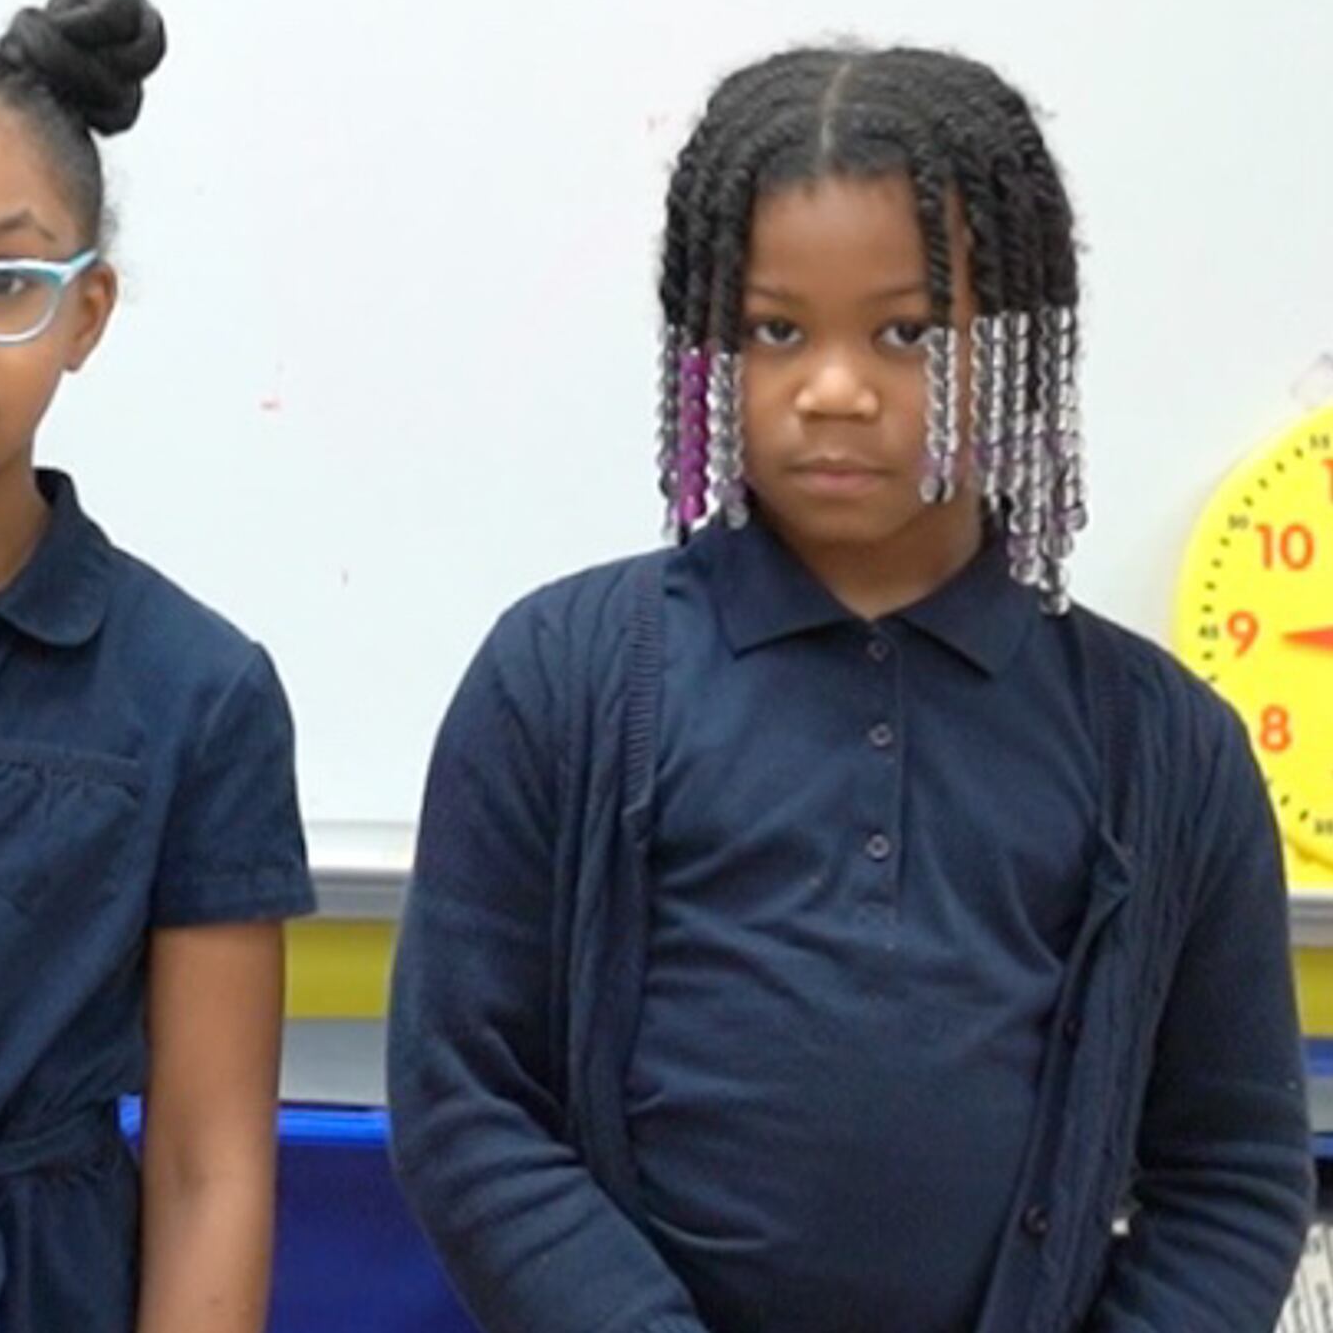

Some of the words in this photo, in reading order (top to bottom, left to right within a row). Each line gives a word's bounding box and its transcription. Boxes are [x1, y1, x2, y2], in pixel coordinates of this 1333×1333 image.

[1254, 522, 1315, 572] 10
[1225, 609, 1260, 658] 9
[1259, 703, 1292, 754] 8
